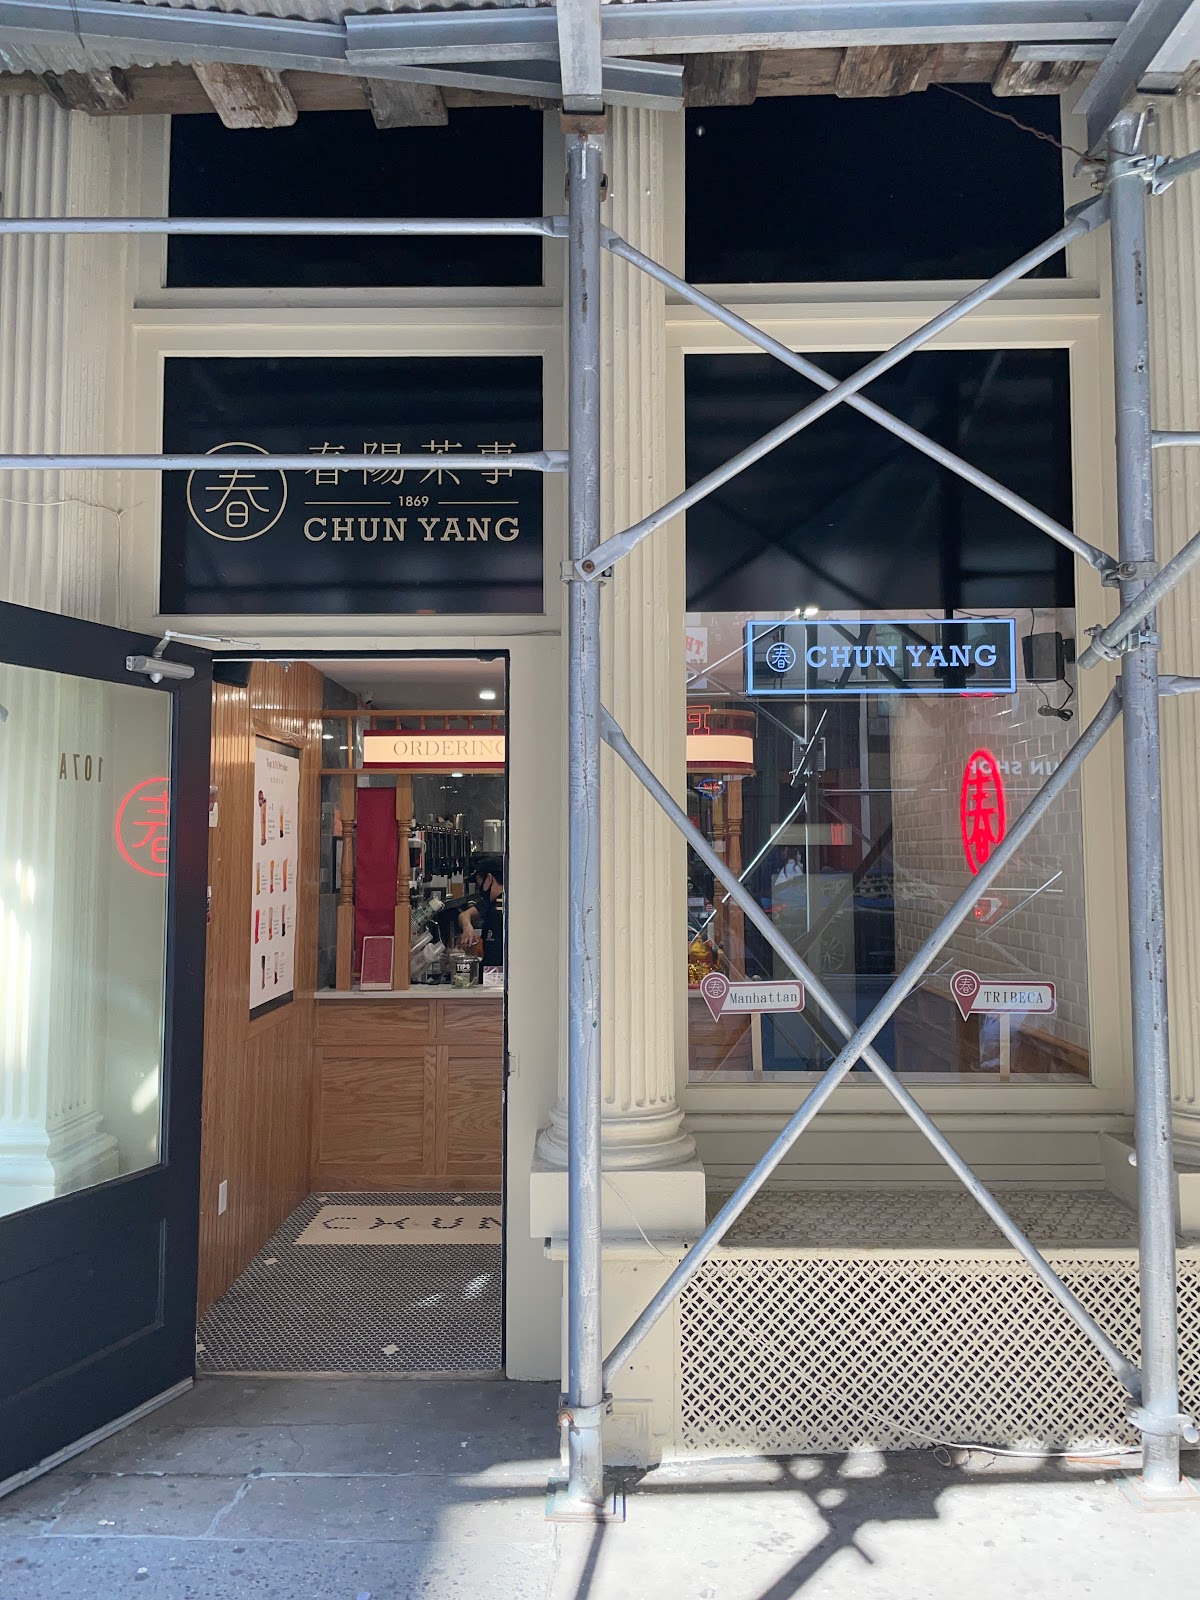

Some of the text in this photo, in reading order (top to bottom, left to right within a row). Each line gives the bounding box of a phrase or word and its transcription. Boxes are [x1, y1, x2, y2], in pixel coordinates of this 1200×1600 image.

[399, 495, 430, 507] 1869
[303, 517, 520, 542] CHUN YANG
[806, 644, 997, 668] CHUN YANG
[729, 991, 798, 1004] Manhattan
[984, 991, 1044, 1004] TRIBECA
